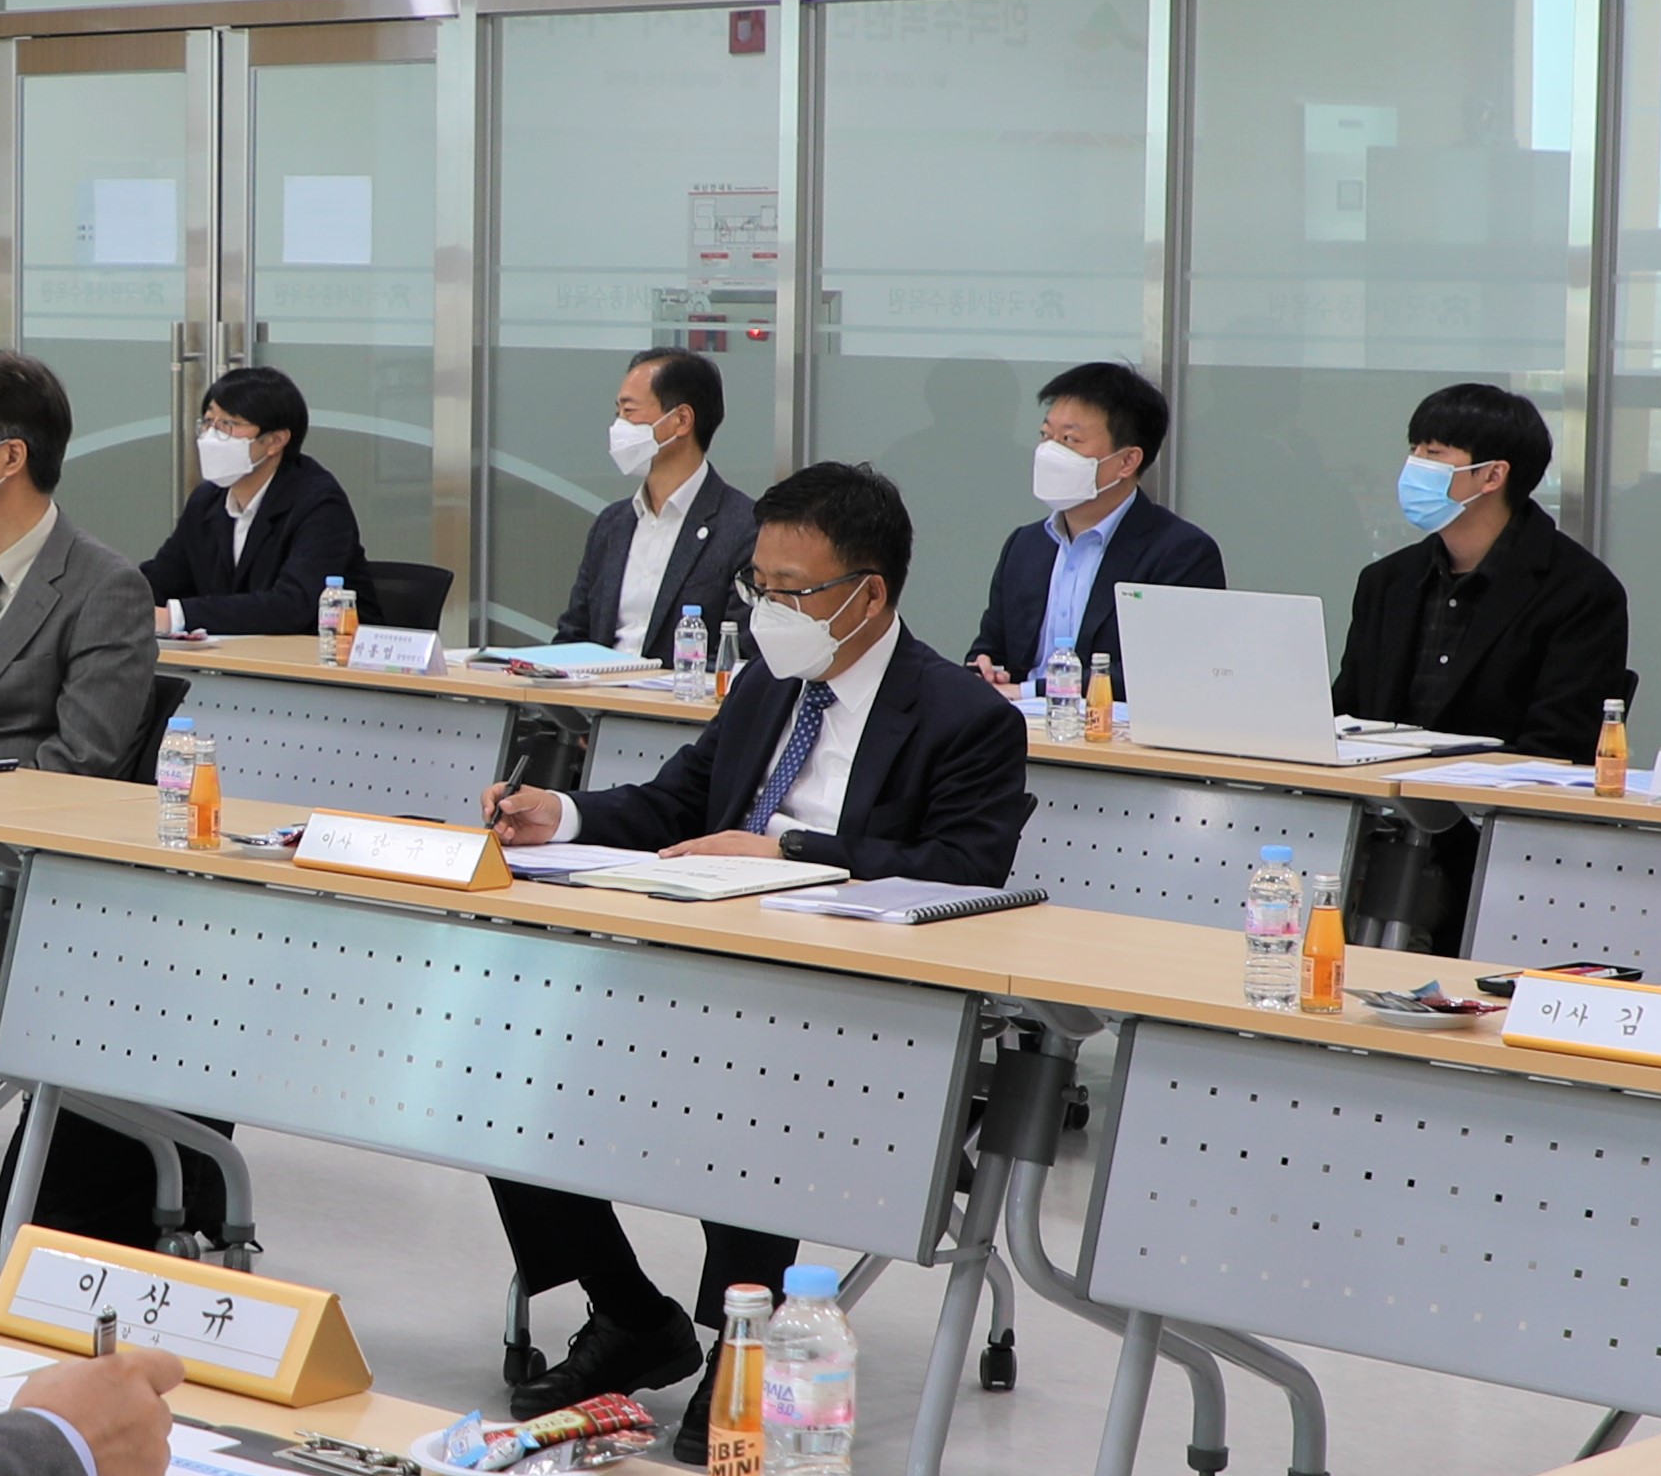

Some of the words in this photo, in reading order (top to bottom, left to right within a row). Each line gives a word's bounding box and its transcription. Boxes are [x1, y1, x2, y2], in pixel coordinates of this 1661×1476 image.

[321, 829, 352, 850] 이사
[1540, 999, 1589, 1027] 이사
[78, 1267, 235, 1341] 이상규
